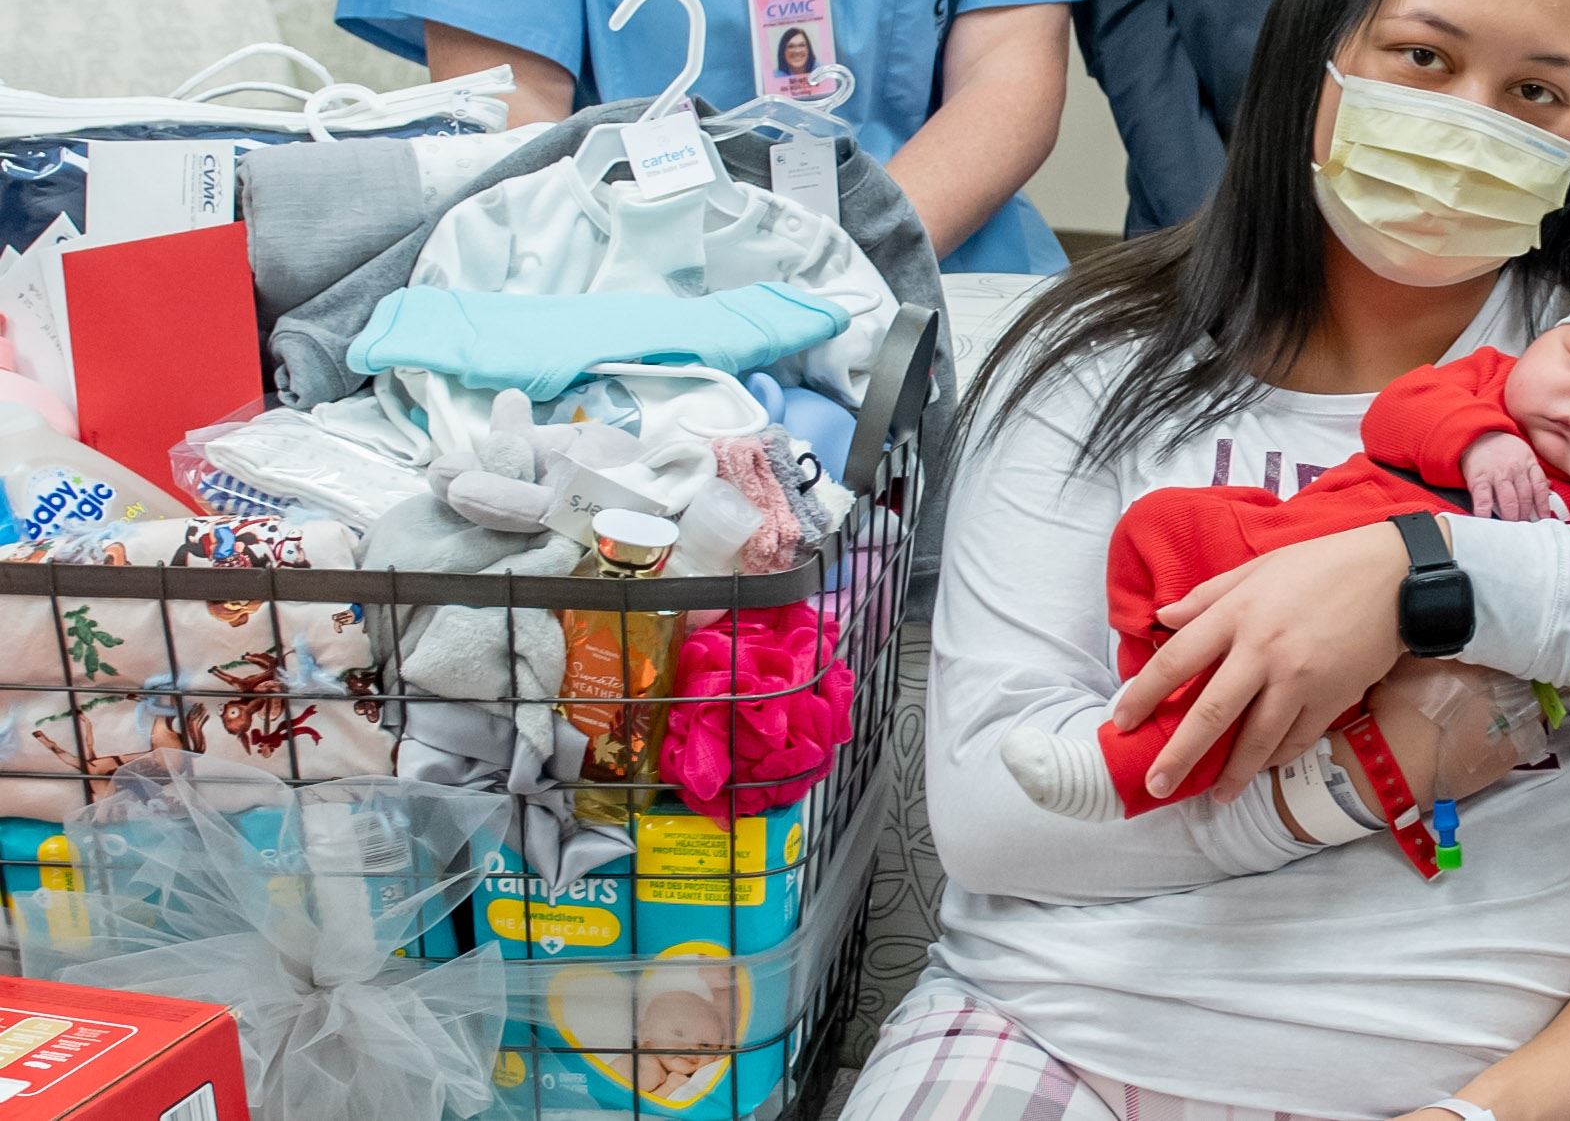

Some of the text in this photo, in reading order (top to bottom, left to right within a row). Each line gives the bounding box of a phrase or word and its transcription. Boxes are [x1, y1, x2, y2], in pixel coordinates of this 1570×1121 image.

[641, 145, 697, 168] carter's
[203, 154, 216, 214] CVMC
[570, 494, 603, 517] er's
[523, 909, 585, 924] waddlers
